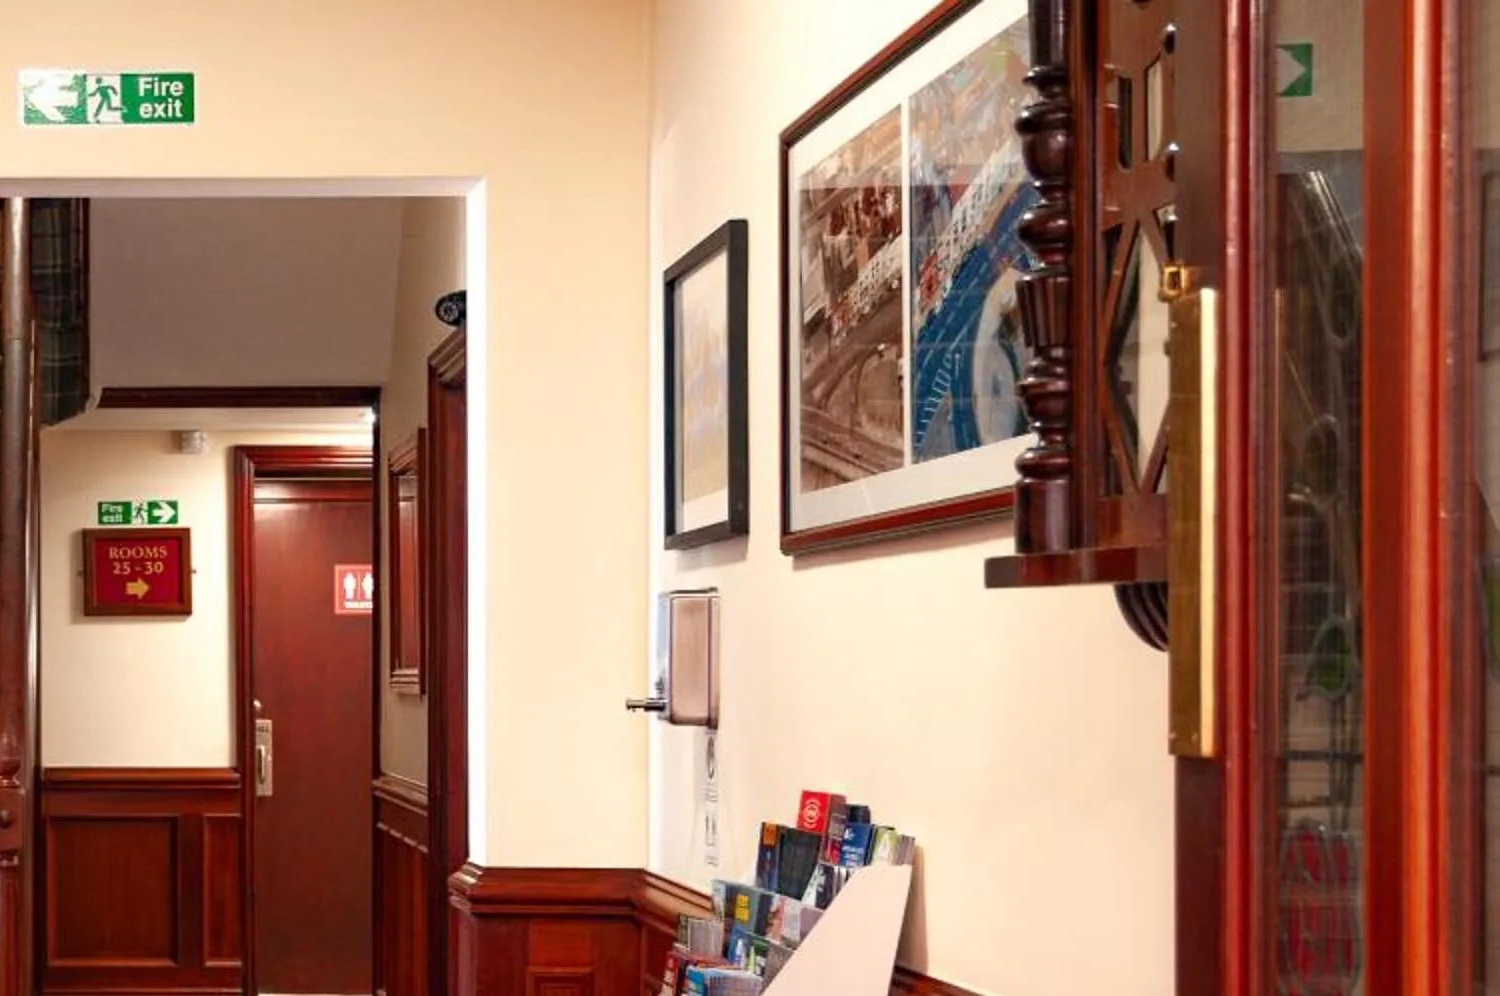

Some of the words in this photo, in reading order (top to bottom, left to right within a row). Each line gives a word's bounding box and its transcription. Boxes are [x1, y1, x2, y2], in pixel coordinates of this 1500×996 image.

[138, 77, 184, 97] Fire
[139, 98, 183, 118] exit
[109, 546, 168, 559] ROOMS
[113, 561, 131, 575] 25
[144, 561, 164, 575] 30
